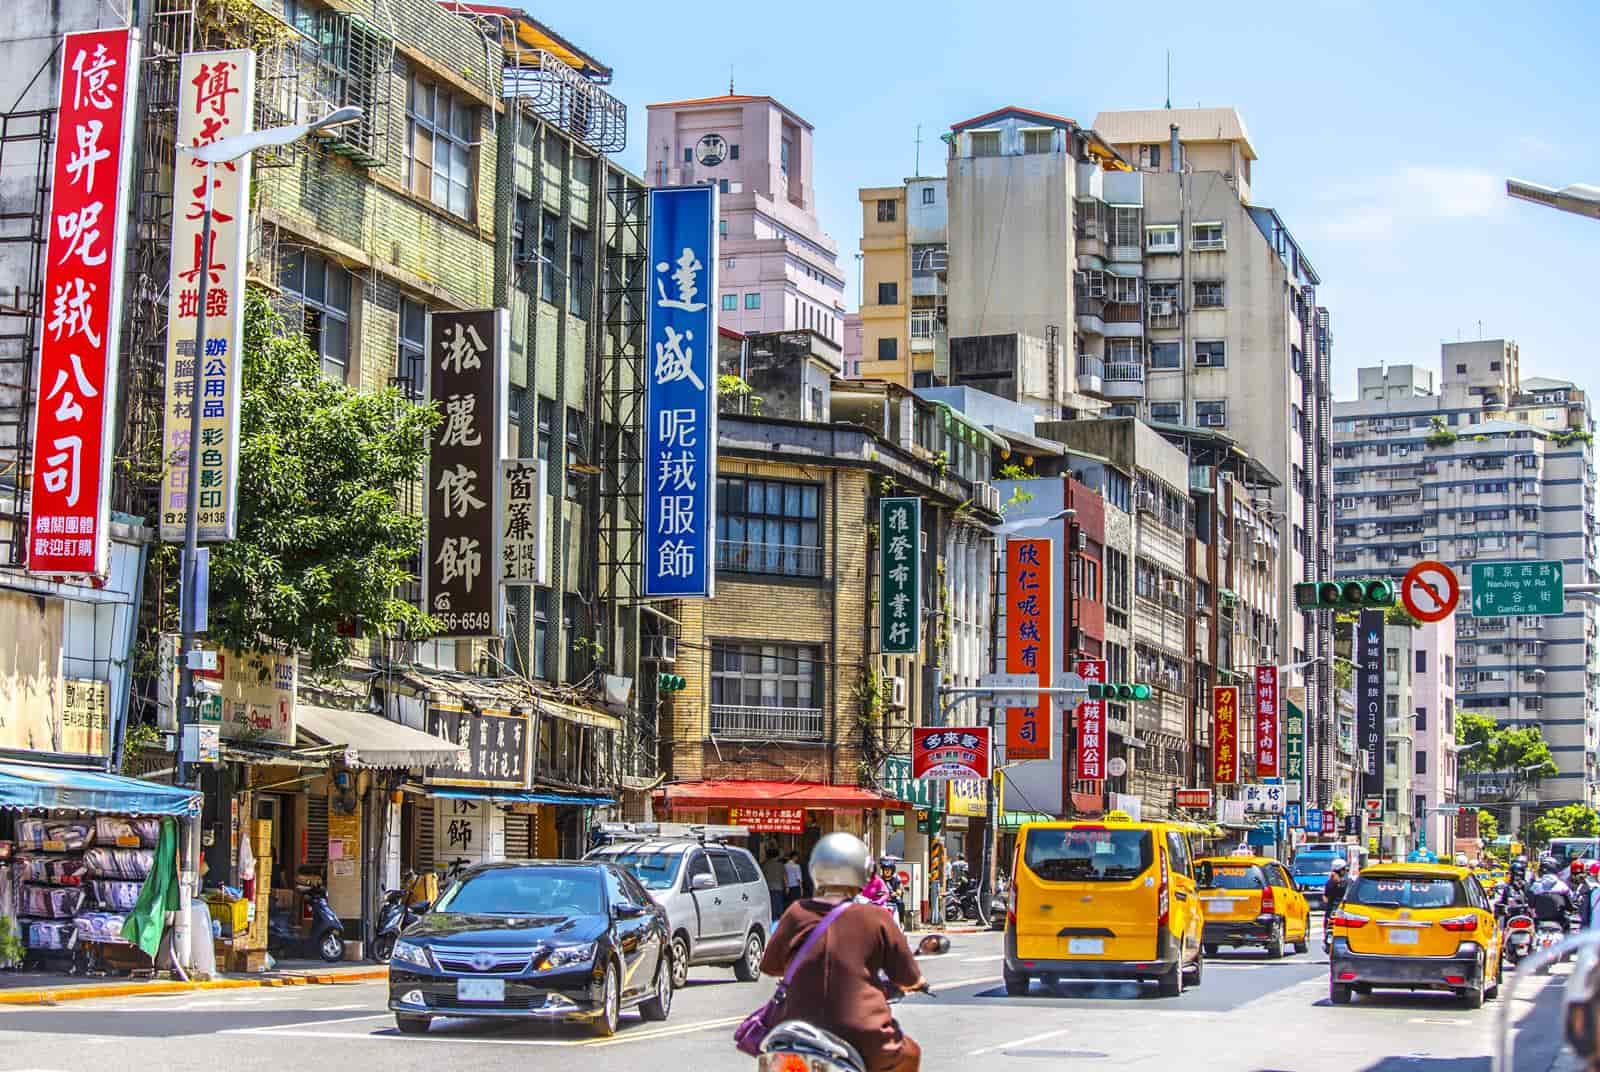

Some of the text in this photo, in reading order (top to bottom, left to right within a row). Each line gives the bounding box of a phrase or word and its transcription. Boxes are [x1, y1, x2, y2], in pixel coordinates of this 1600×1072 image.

[178, 288, 228, 319] 批發
[203, 338, 228, 418] 辦公用品
[200, 427, 223, 509] 彩色影印
[506, 462, 537, 541] 窗簾
[177, 511, 226, 525] 25-9138
[35, 537, 93, 557] 歡迎訂購
[1483, 565, 1551, 578] 南京西路
[1484, 591, 1552, 604] 甘谷街
[1016, 543, 1041, 744] 欣仁呢絨有司
[274, 663, 294, 681] PLUS
